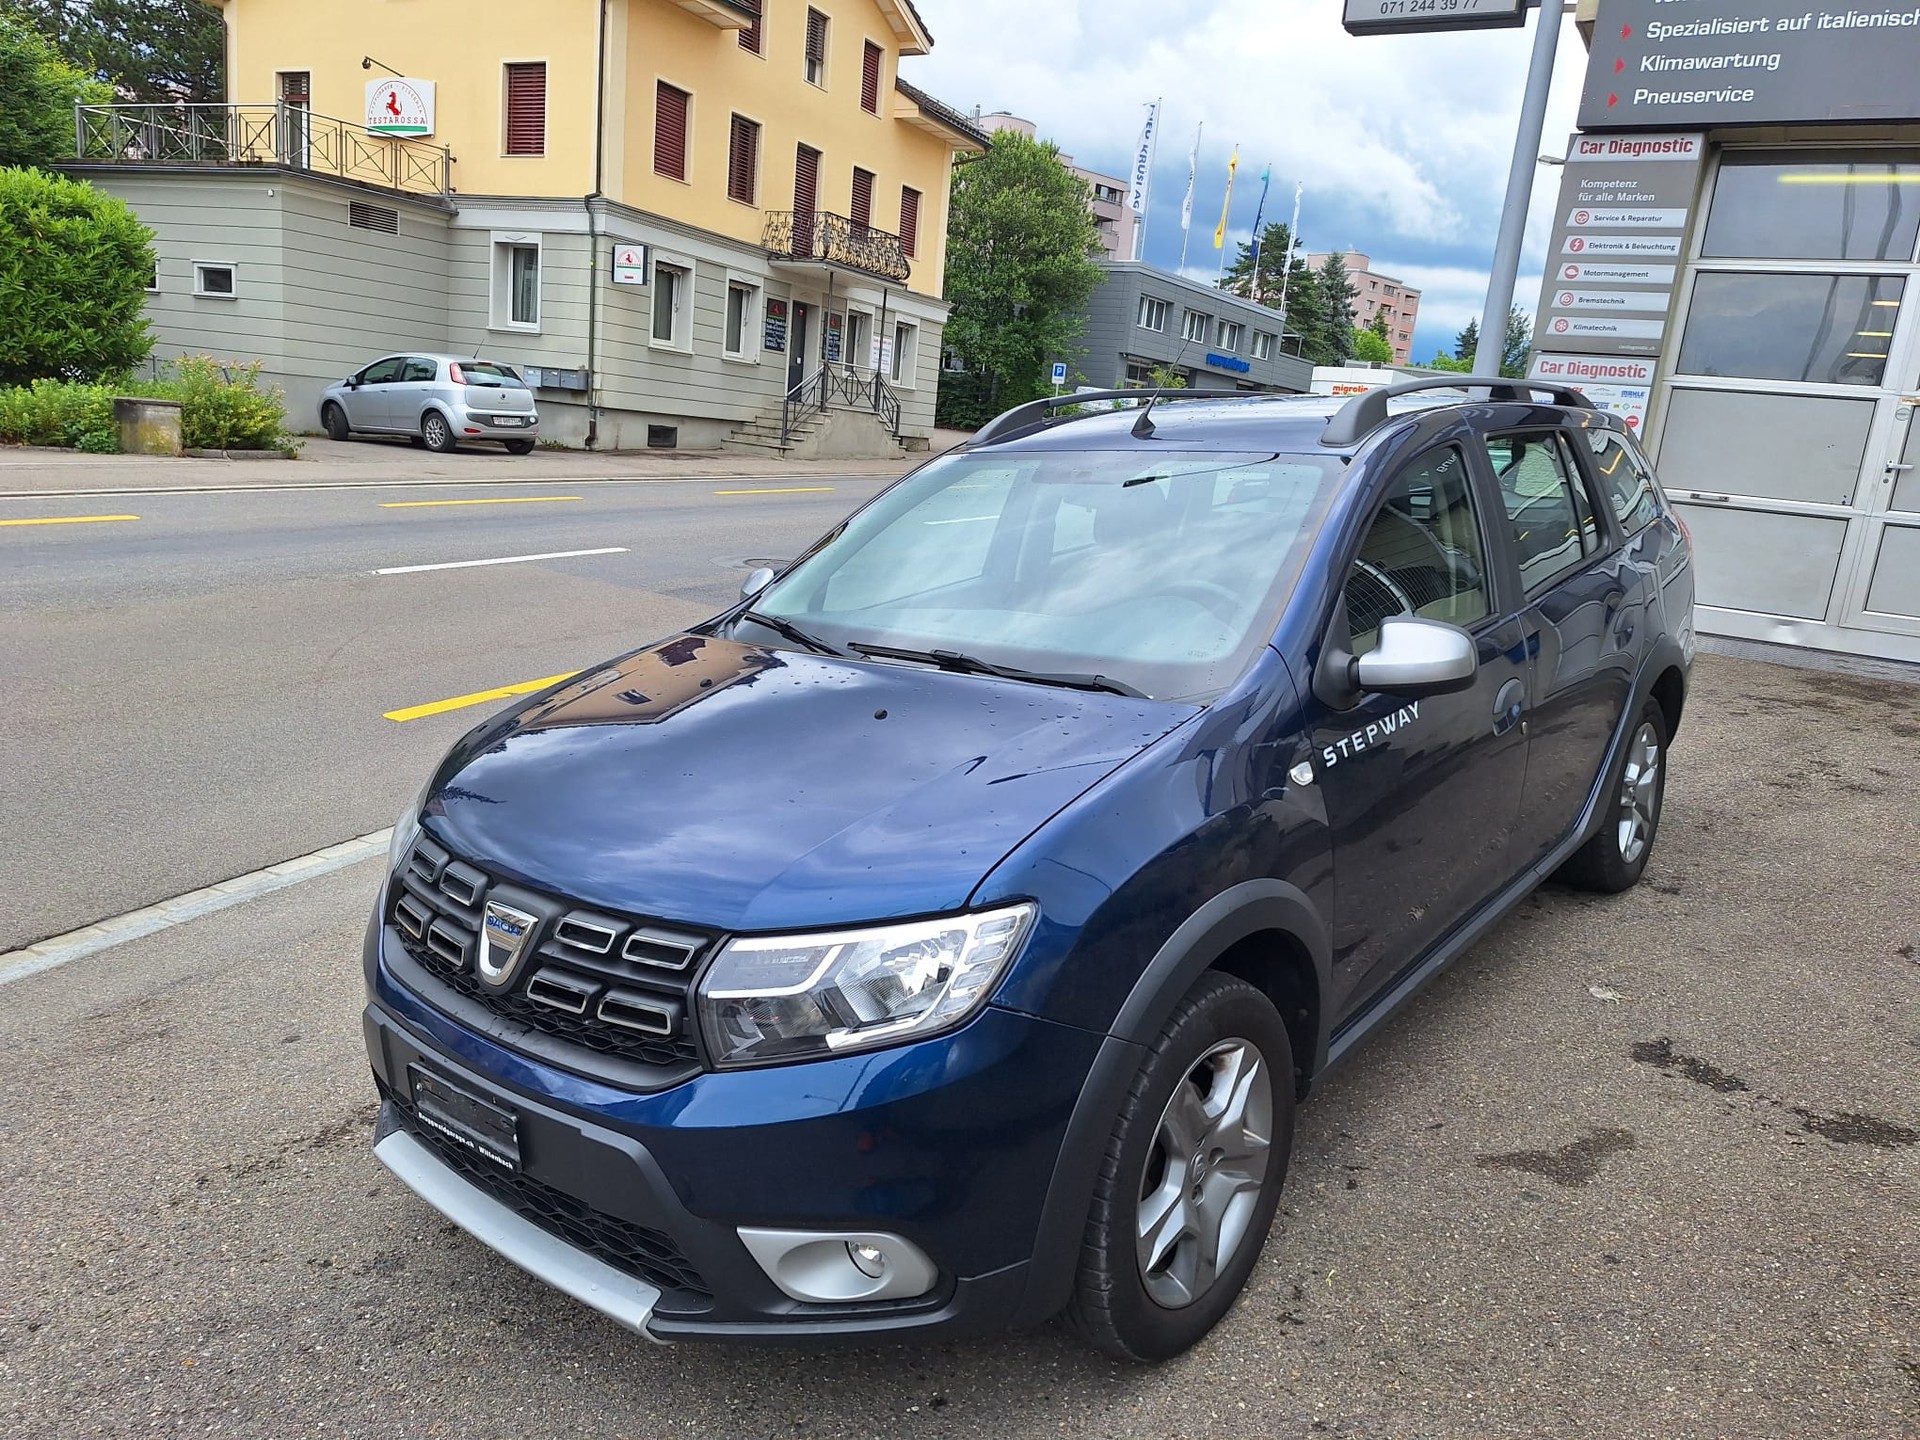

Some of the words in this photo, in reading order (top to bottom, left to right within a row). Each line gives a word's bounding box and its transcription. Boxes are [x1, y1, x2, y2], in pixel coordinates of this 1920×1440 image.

[1380, 1, 1404, 14] 071
[1409, 0, 1435, 13] 244
[1440, 0, 1457, 10] 39
[1646, 17, 1769, 42] Spezialisiert
[1776, 13, 1812, 31] auf
[1640, 53, 1781, 72] Klimawartung
[1633, 86, 1754, 105] Pneuservice
[368, 116, 426, 125] TESTAROSSA
[1579, 140, 1605, 154] Car
[1608, 138, 1694, 157] Diagnostic
[1580, 179, 1638, 190] Kompetenz
[1133, 191, 1142, 209] AG
[1577, 192, 1593, 202] für
[1595, 192, 1614, 201] alle
[1616, 192, 1656, 202] Marken
[1627, 215, 1662, 223] Reparatur
[1588, 242, 1624, 250] Elektronik
[1631, 243, 1676, 252] Beleuchtung
[1583, 269, 1649, 280] Motormanagement
[1578, 296, 1626, 305] Bremstechnik
[1572, 323, 1618, 332] Klimatechnik
[1539, 360, 1563, 375] Car
[1567, 361, 1648, 380] Diagnostic
[1323, 700, 1420, 768] STEPWAY
[487, 915, 523, 937] DACIA
